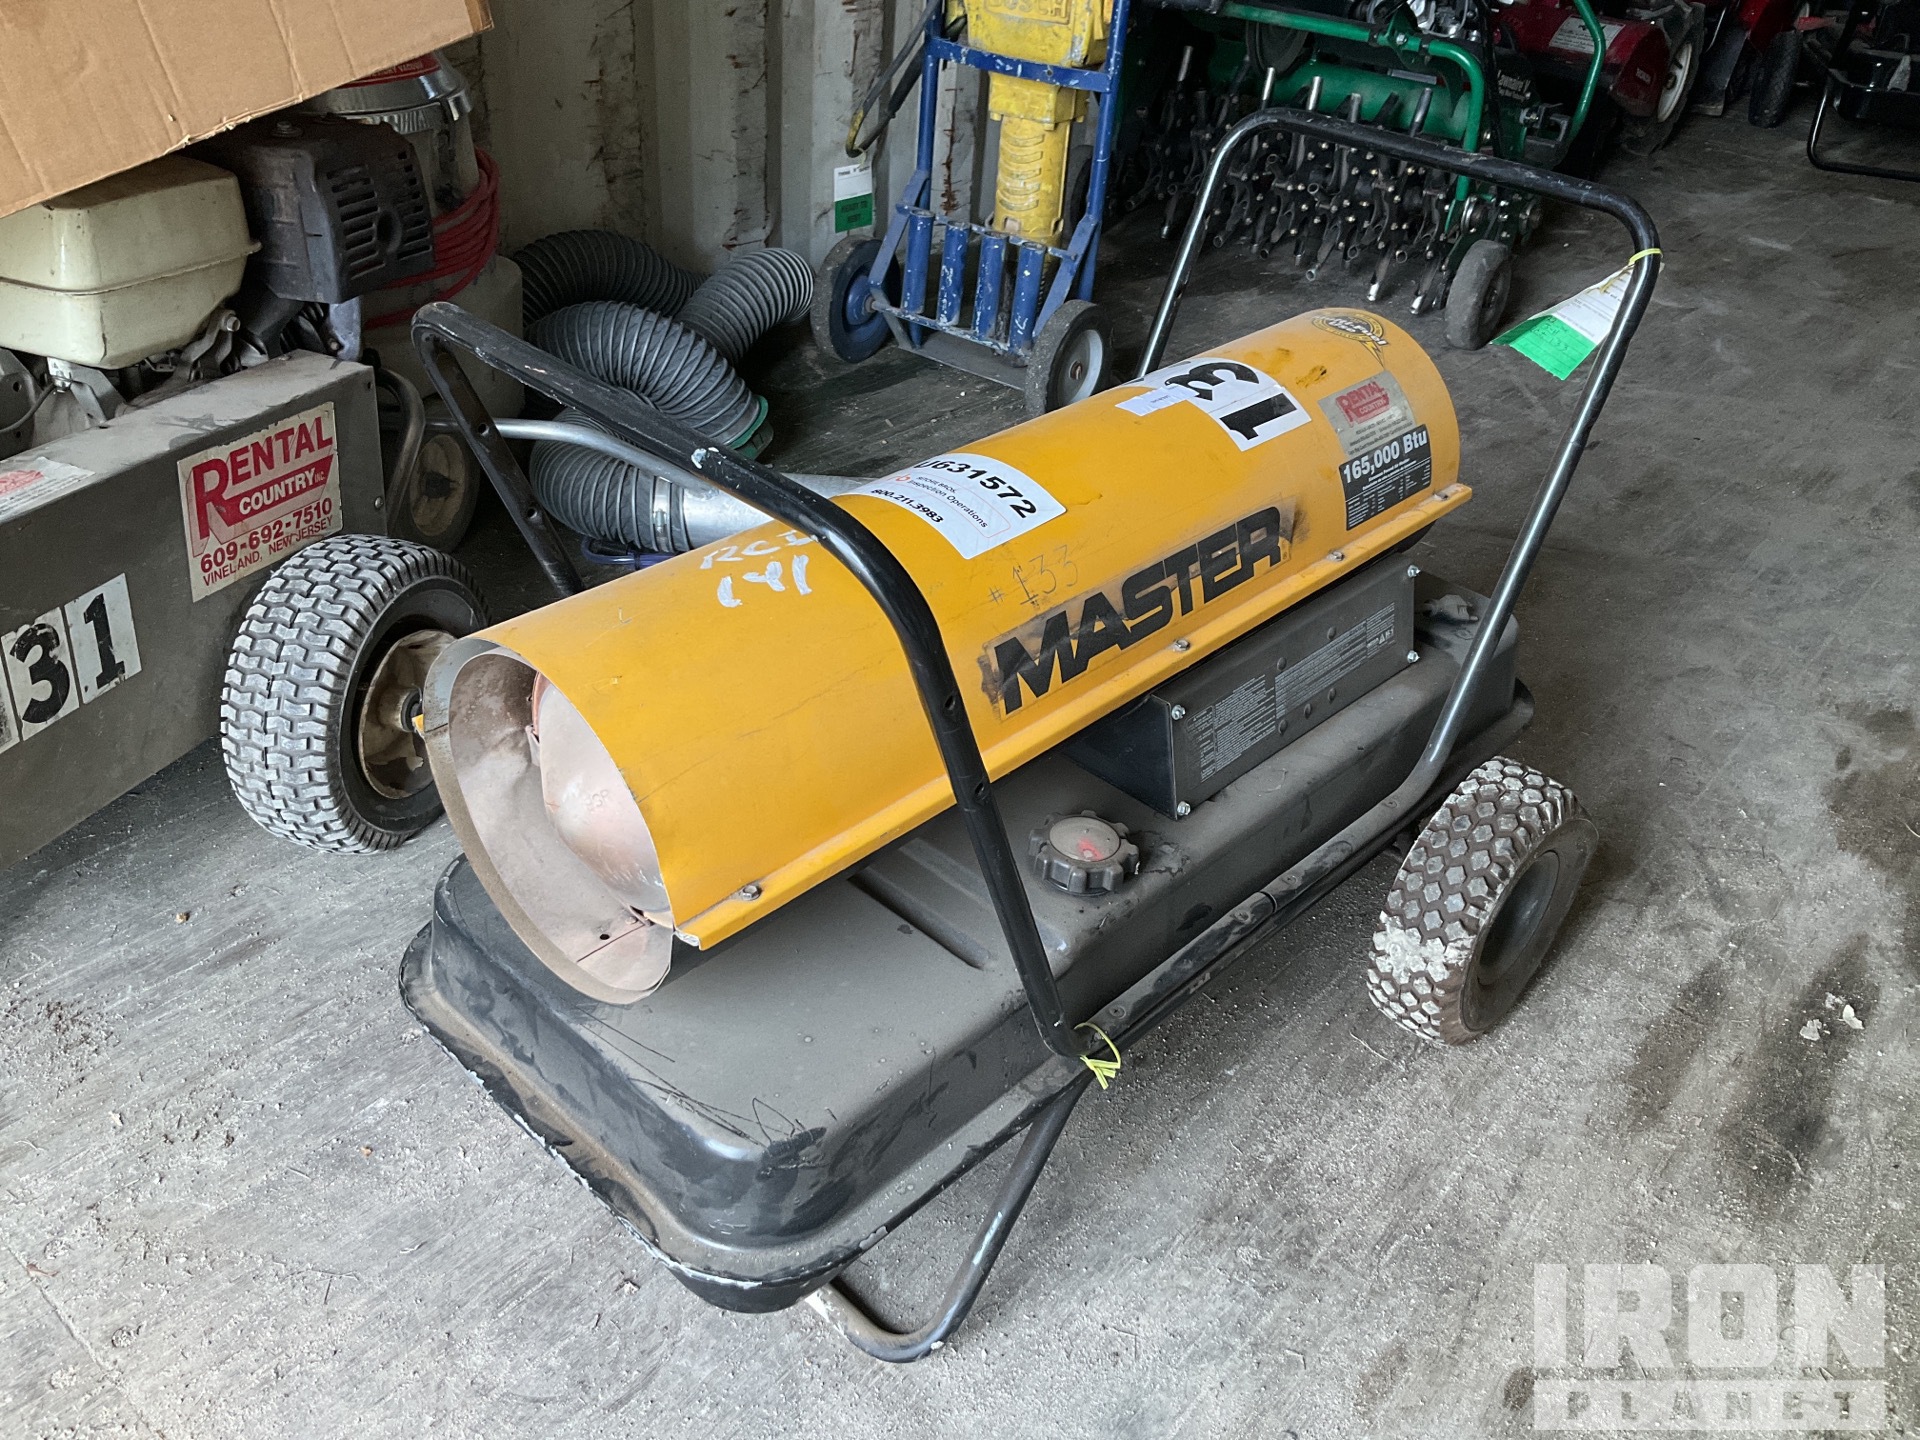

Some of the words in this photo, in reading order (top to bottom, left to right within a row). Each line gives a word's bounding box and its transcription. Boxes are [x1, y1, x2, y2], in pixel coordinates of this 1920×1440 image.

[192, 416, 333, 540] RENTAL
[1344, 441, 1400, 483] 165,000
[1403, 430, 1428, 454] Btu
[239, 467, 316, 515] COUNTRY
[871, 488, 944, 523] 800.211.3983
[908, 479, 946, 497] Inspection
[946, 493, 988, 528] Operations
[200, 498, 332, 573] 609-692-7510
[203, 551, 263, 587] VINELAND,
[268, 534, 293, 555] NEW
[294, 515, 333, 542] JERSEY
[994, 506, 1281, 715] MASTER
